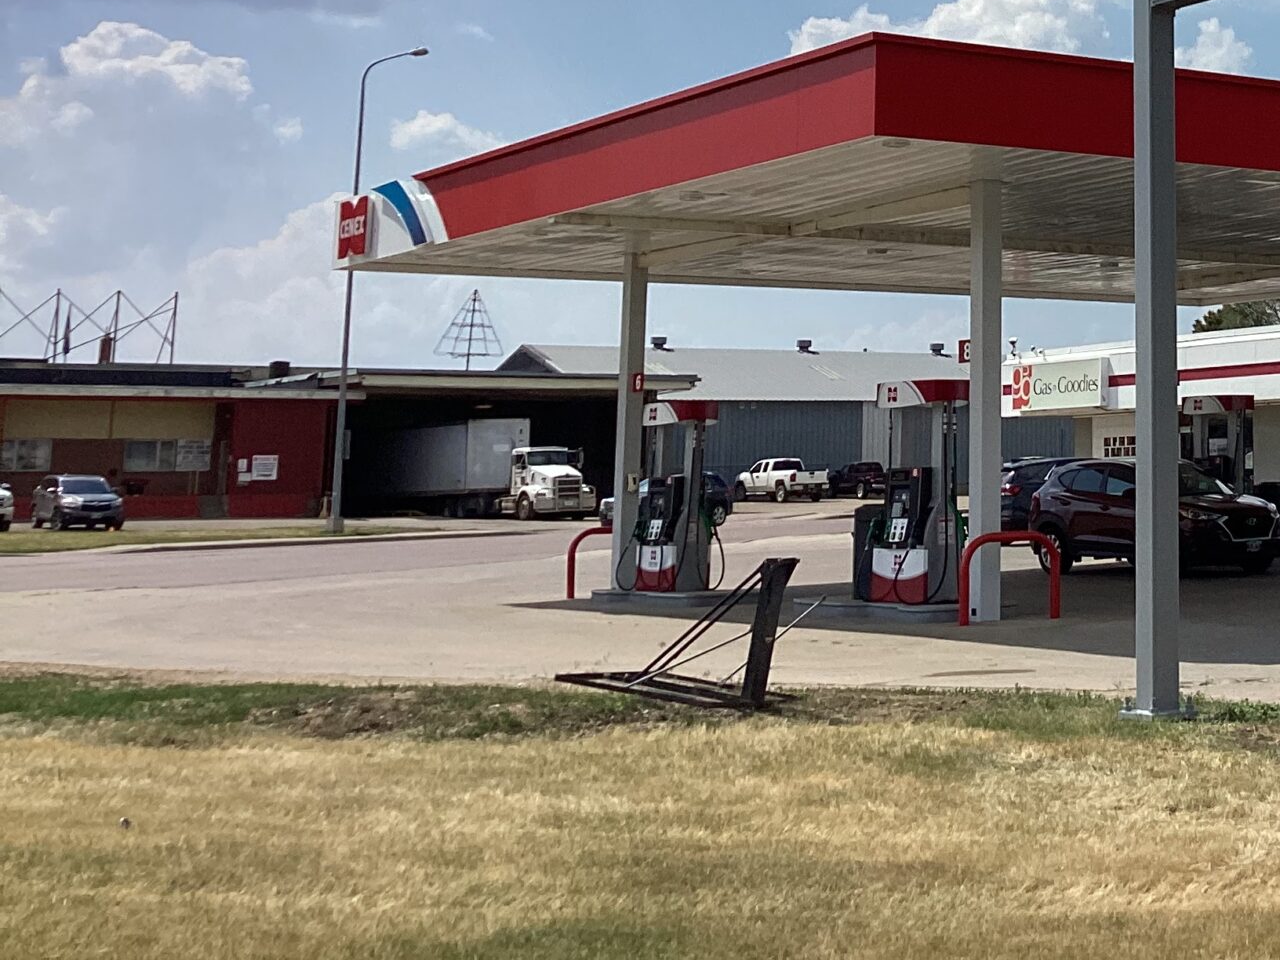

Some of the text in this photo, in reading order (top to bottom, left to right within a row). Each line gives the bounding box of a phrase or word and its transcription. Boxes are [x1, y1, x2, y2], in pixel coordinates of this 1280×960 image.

[635, 374, 642, 390] 6
[1033, 378, 1053, 396] Gas
[1057, 373, 1099, 394] Goodies
